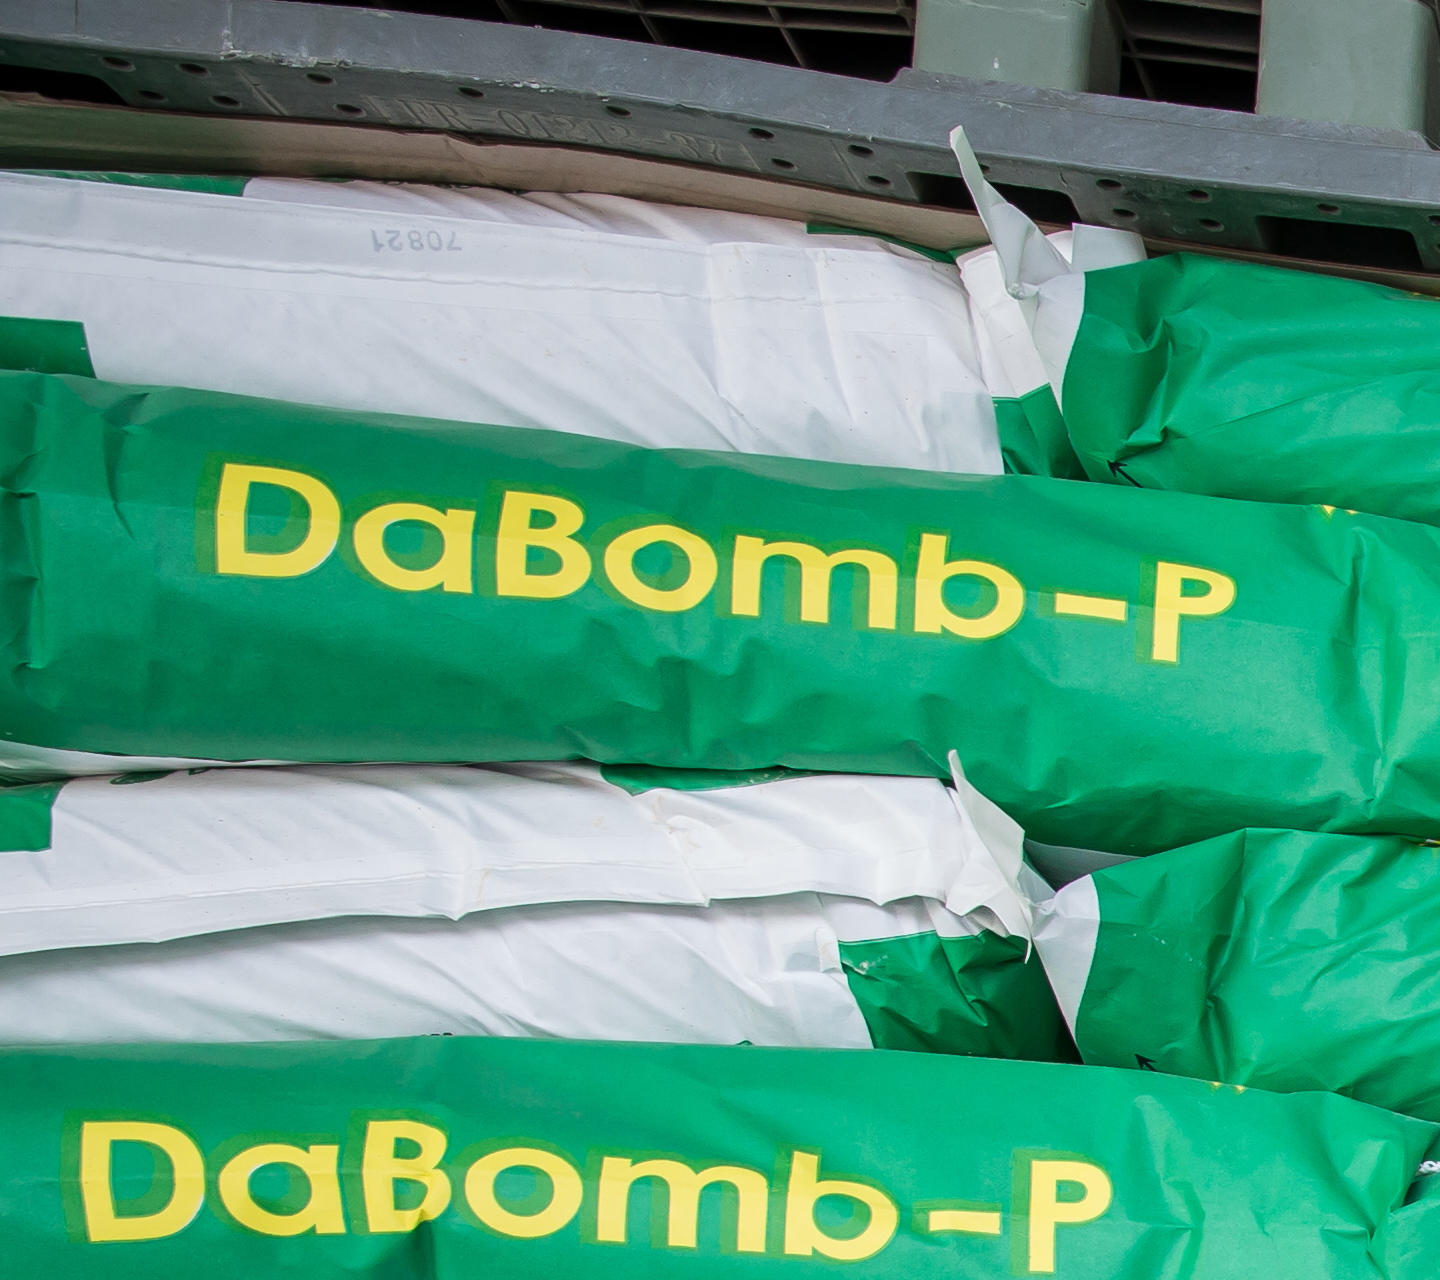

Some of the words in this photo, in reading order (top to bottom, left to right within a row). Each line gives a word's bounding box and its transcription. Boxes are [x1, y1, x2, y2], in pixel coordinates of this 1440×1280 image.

[370, 228, 463, 254] 70821
[215, 462, 1235, 662] DaBomb-P
[79, 1119, 1111, 1272] DaBomb-P
